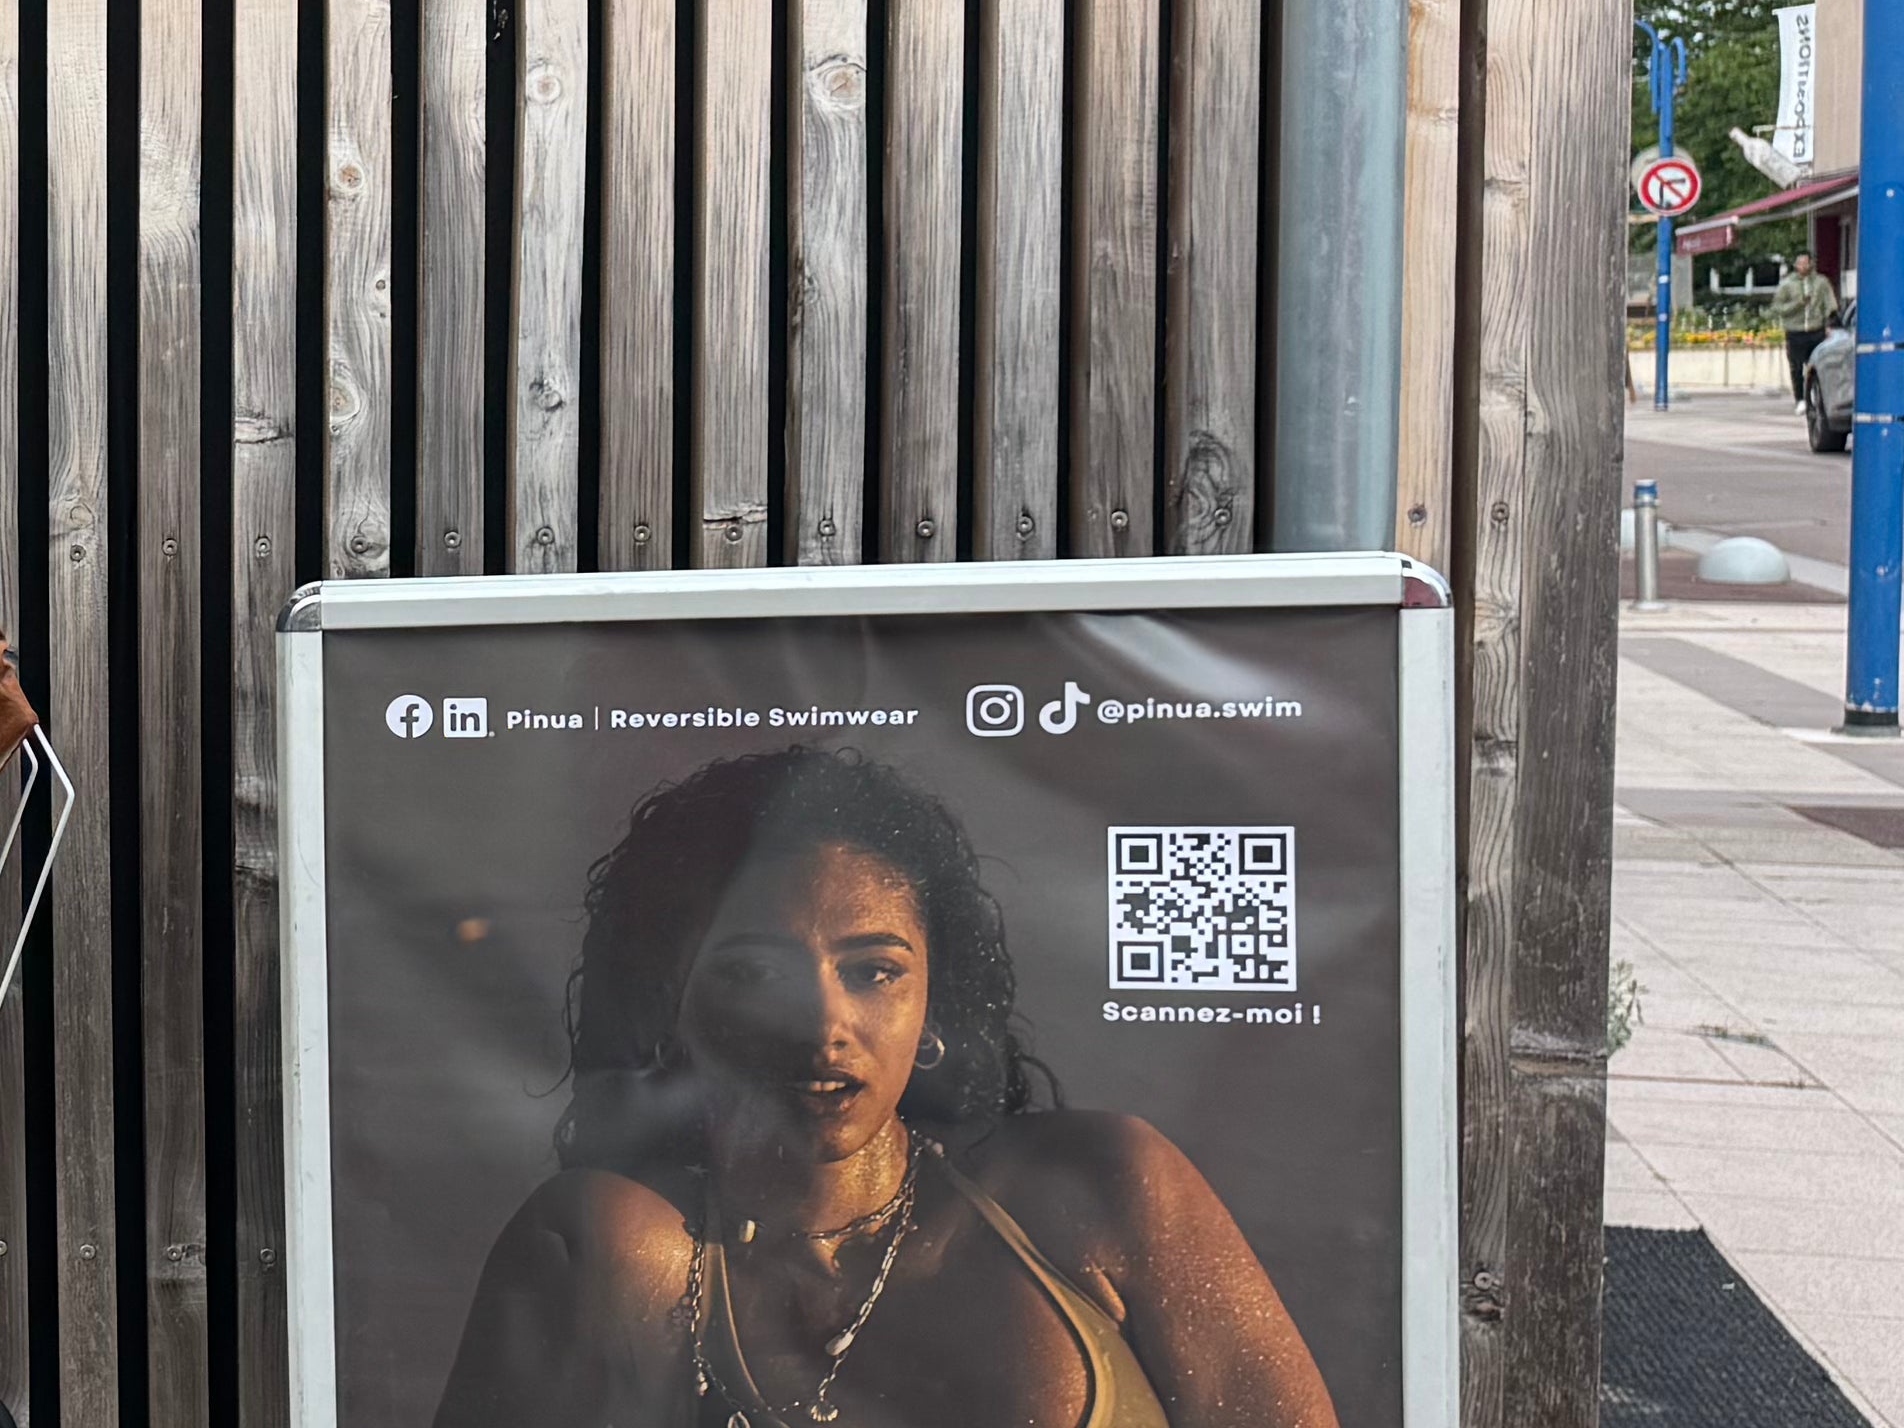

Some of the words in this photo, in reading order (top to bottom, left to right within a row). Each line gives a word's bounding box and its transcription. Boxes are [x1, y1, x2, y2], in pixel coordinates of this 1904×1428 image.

[506, 709, 584, 730] Pinua
[610, 707, 761, 730] Reversible
[768, 705, 920, 728] Swimwear
[1096, 695, 1303, 724] @pinua.swim
[1102, 1001, 1304, 1025] Scannez-moi
